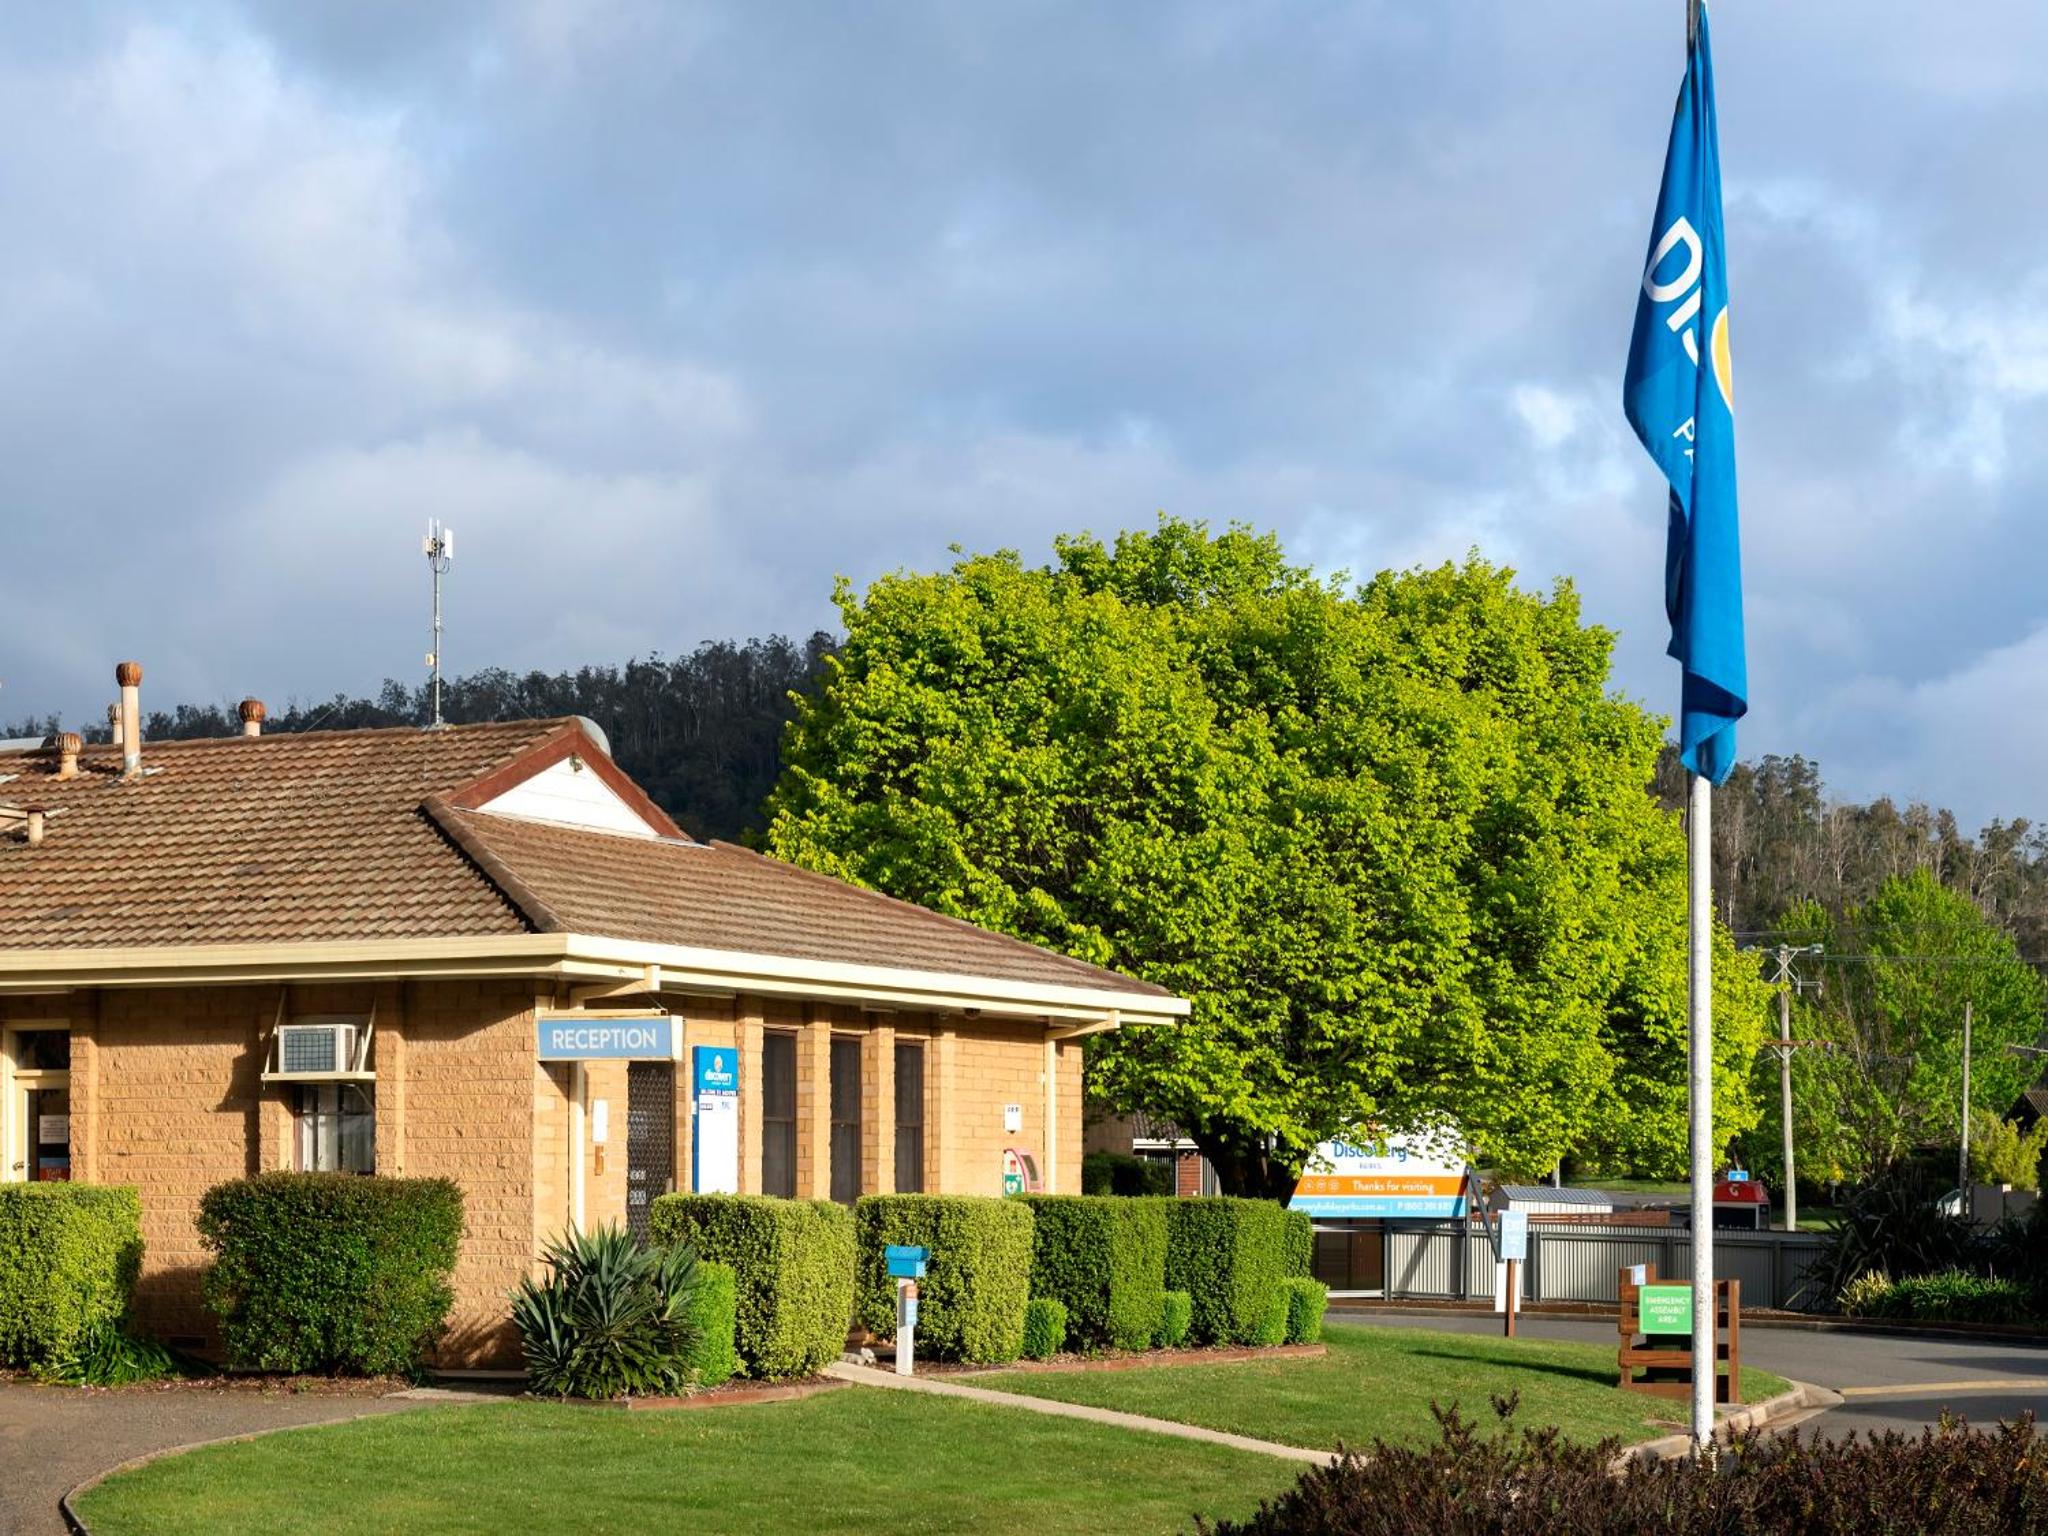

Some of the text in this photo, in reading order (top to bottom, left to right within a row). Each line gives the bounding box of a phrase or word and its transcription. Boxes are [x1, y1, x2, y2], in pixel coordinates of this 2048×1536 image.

[552, 1027, 657, 1049] RECEPTION
[1353, 1180, 1434, 1195] Thanks for visiting
[1645, 1296, 1690, 1305] EMERGENCY
[1649, 1305, 1687, 1314] ASSEMBLY
[1657, 1315, 1678, 1323] AREA
